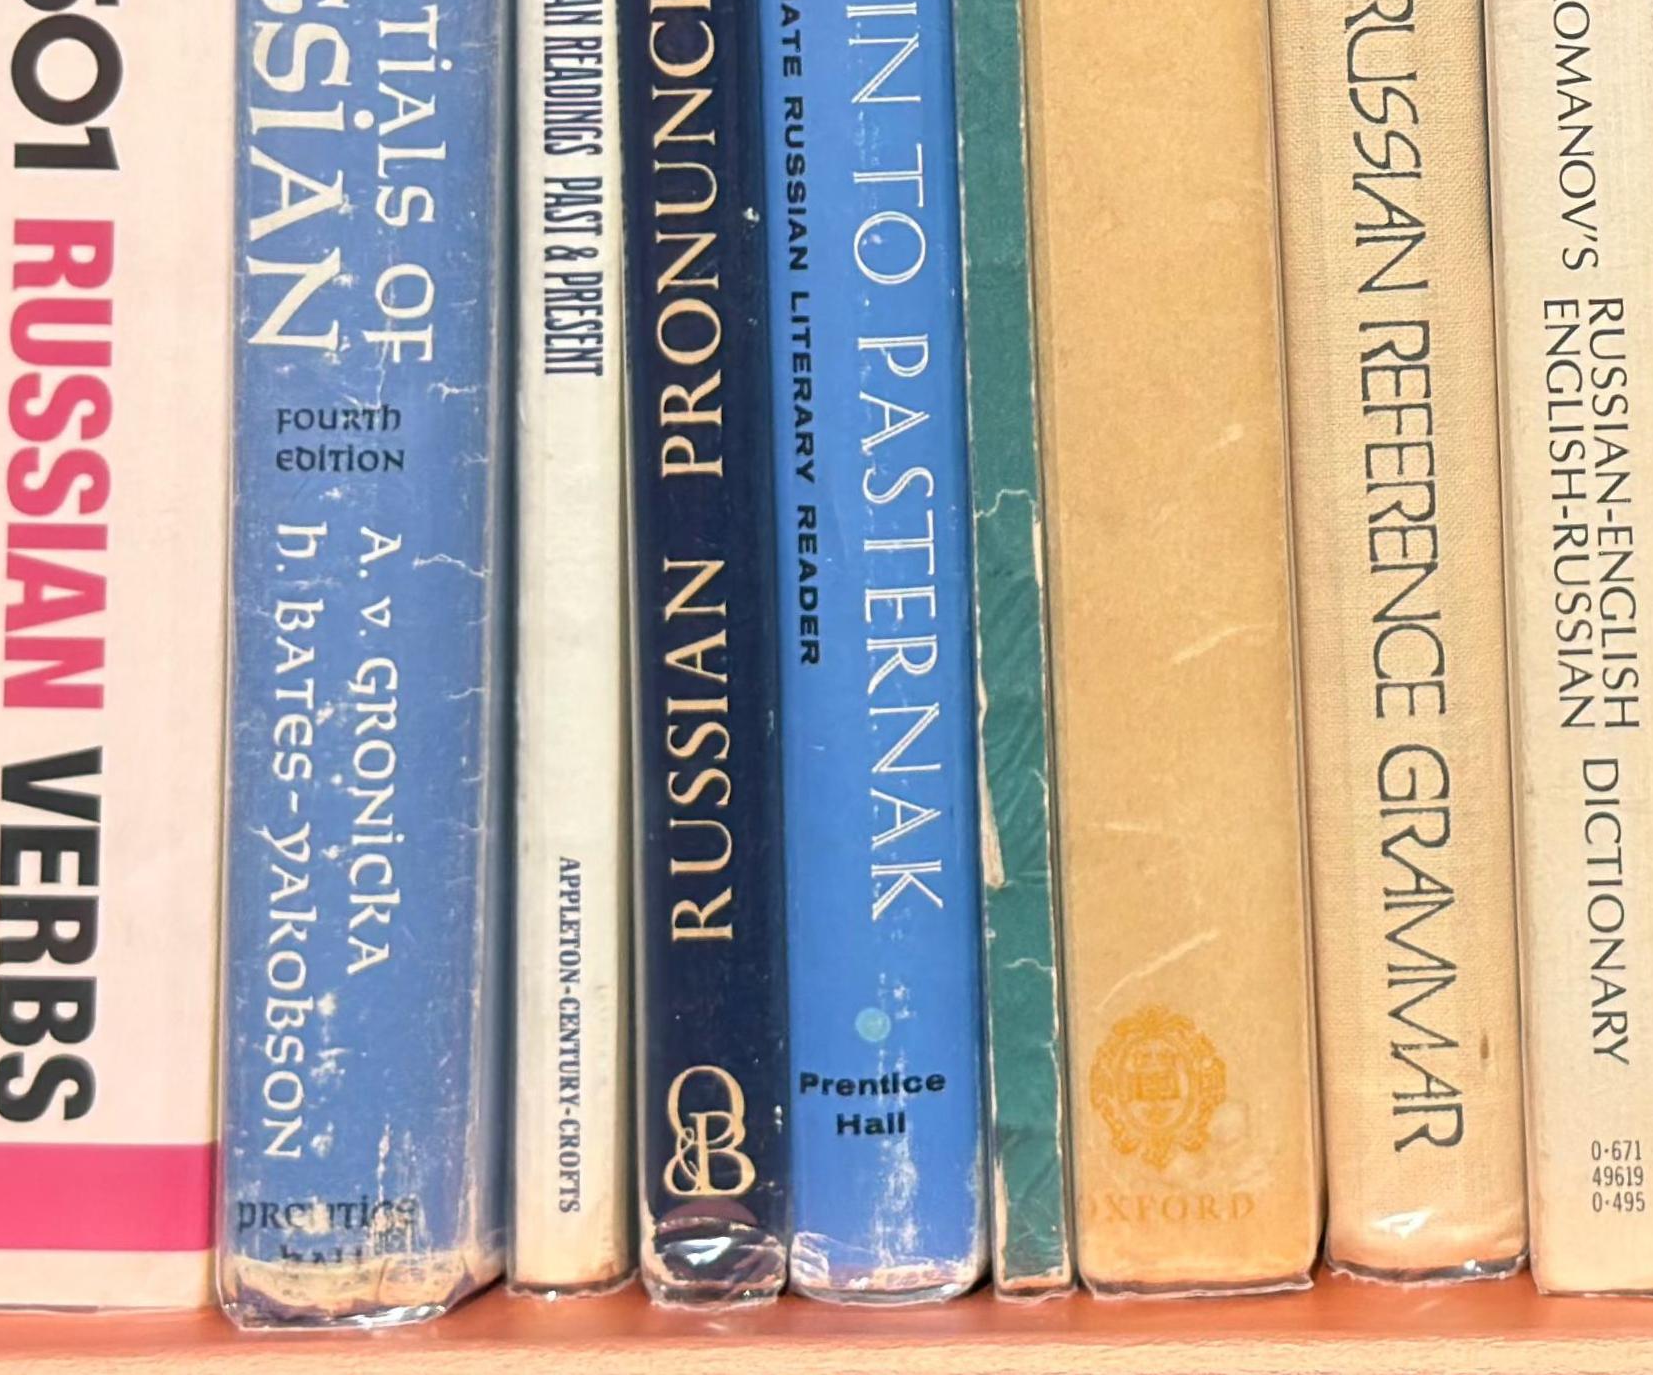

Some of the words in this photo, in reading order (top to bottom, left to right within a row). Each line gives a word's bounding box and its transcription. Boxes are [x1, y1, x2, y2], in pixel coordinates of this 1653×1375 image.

[543, 35, 603, 157] READINGS
[783, 95, 810, 272] RUSSIAN
[543, 176, 603, 240] PAST
[851, 142, 927, 285] TO
[363, 262, 435, 364] OF
[543, 272, 604, 377] PRESENT
[790, 291, 817, 485] LITERARY
[2, 218, 115, 710] RUSSIAN
[1358, 319, 1447, 720] REFERENCE
[1586, 296, 1641, 729] RUSSIAN-ENGLISH
[797, 504, 821, 666] READER
[856, 334, 945, 920] PASTERNAK
[663, 559, 735, 942] RUSSIAN
[1542, 298, 1597, 729] ENGLISH-RUSSIAN
[1582, 757, 1631, 1066] DICTIONARY
[557, 856, 584, 1214] APPLETON-CENTURY-CROFTS
[1377, 742, 1465, 1153] GRAMMAR
[798, 1070, 947, 1097] Prentice
[835, 1111, 909, 1136] Hall
[1590, 1165, 1646, 1189] 49619
